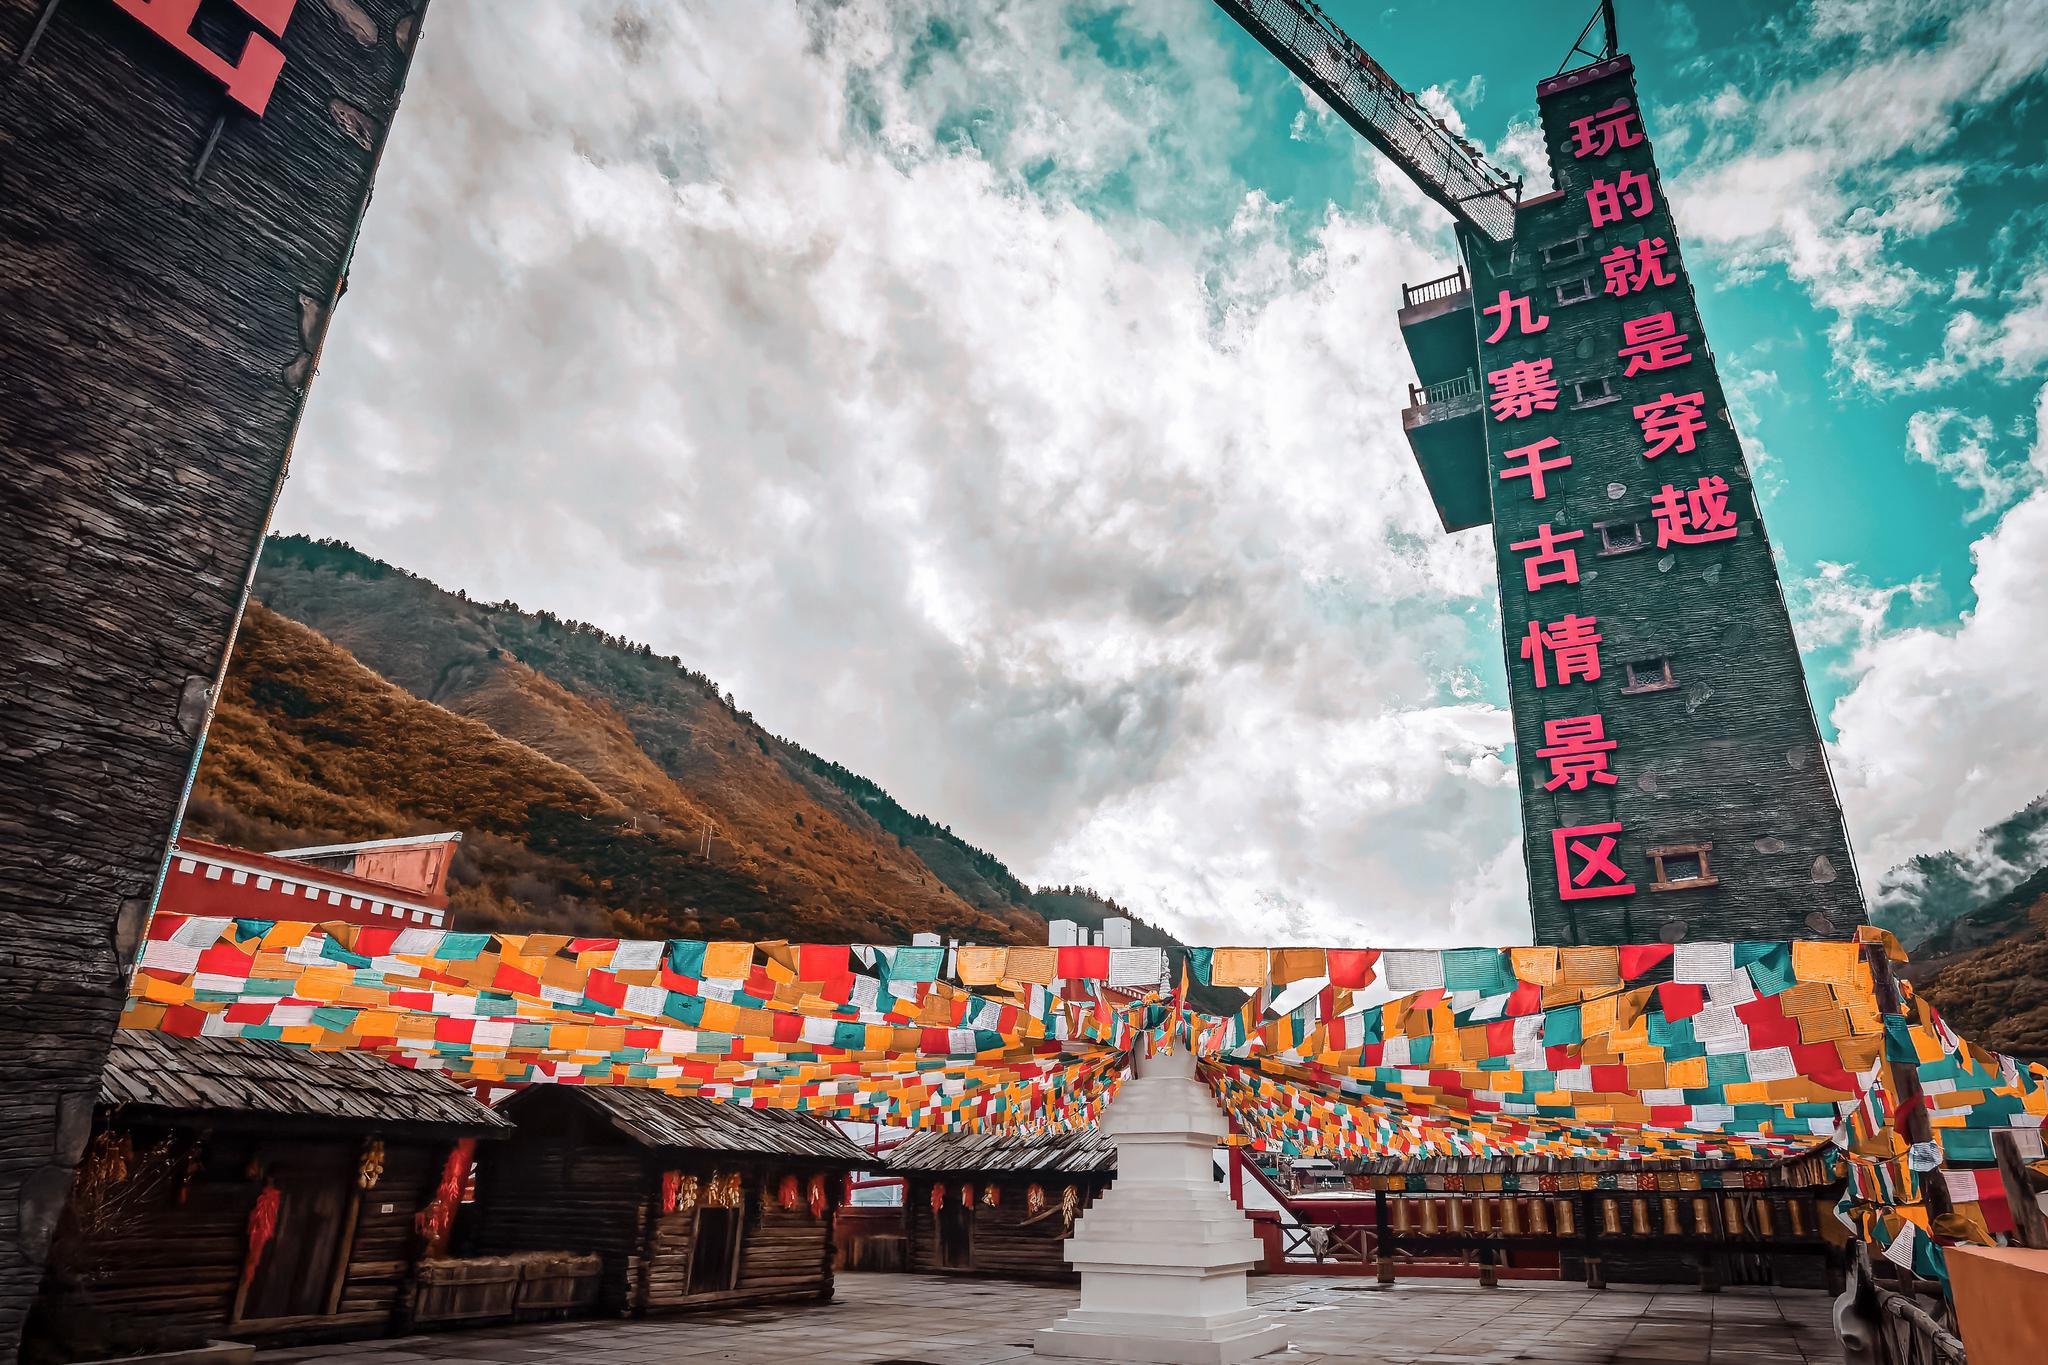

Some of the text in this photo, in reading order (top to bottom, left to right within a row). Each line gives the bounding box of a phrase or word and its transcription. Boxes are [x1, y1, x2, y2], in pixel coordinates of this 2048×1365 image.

[1569, 103, 1738, 549] 玩的就是穿越
[1482, 290, 1636, 901] 九寨千古情景区
